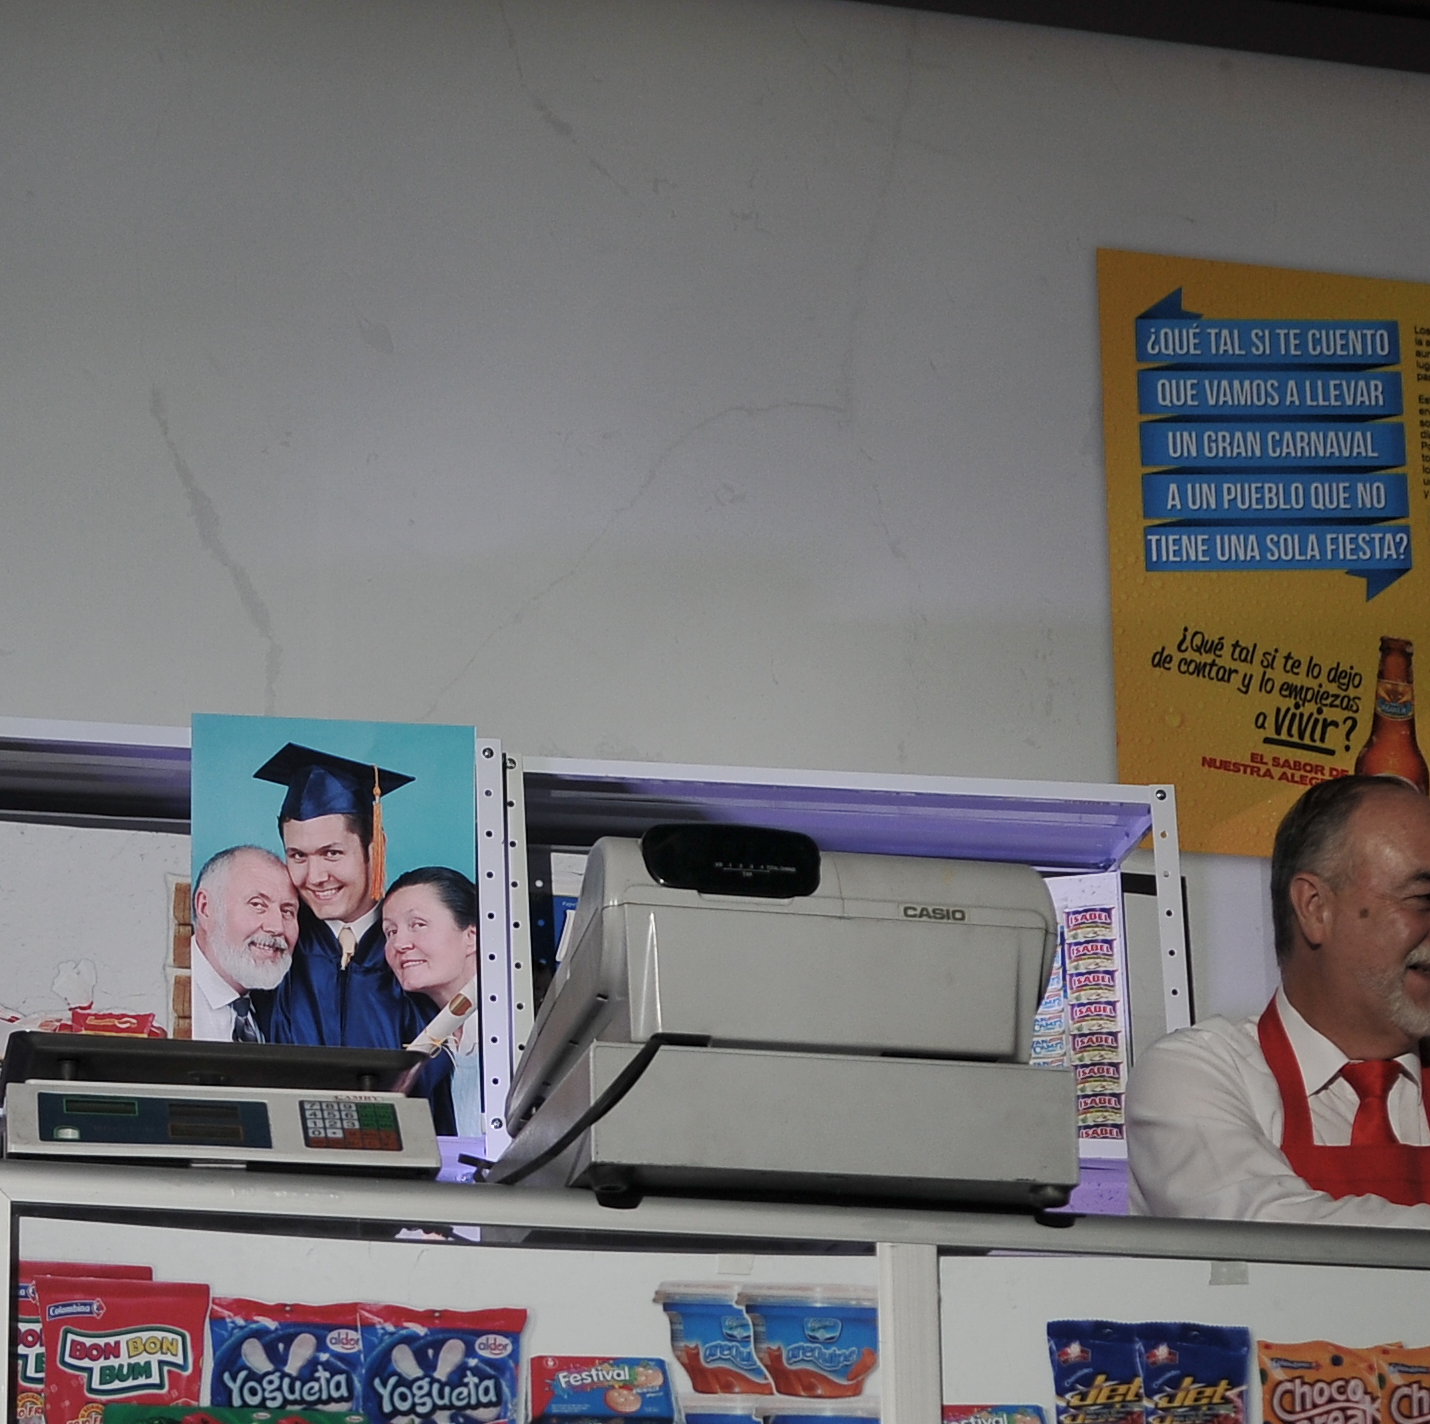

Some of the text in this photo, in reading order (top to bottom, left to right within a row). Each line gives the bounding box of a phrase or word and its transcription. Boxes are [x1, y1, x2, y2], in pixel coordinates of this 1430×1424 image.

[1147, 324, 1389, 356] ¿QUÉ TAL SI TE CUENTO
[1157, 379, 1384, 406] QUE VAMOS A LLEVAR
[1168, 431, 1379, 458] UN GRAN CARNAVAL
[1167, 482, 1386, 510] A UN PUEBLO QUE NO
[1147, 533, 1408, 562] TIENE UNA SOLA FIESTA?
[1177, 626, 1362, 691] ¿Qué tal si te lo dejo
[1152, 647, 1361, 712] de contar y lo empiezas
[1255, 702, 1358, 752] a vivir?
[1201, 757, 1323, 787] NUESTRA ALEG
[1250, 753, 1268, 765] EL
[1272, 757, 1324, 777] SABOR
[903, 905, 966, 922] CASIO
[1071, 912, 1112, 924] ISABEL
[1075, 1005, 1116, 1017] ISABEL
[1079, 1097, 1121, 1108] ISABEL
[71, 1335, 178, 1361] BON BON
[478, 1339, 510, 1354] aldor
[99, 1362, 153, 1384] BUM
[557, 1367, 631, 1389] Festival
[224, 1369, 350, 1409] Yogueta
[375, 1373, 498, 1419] Yogueta
